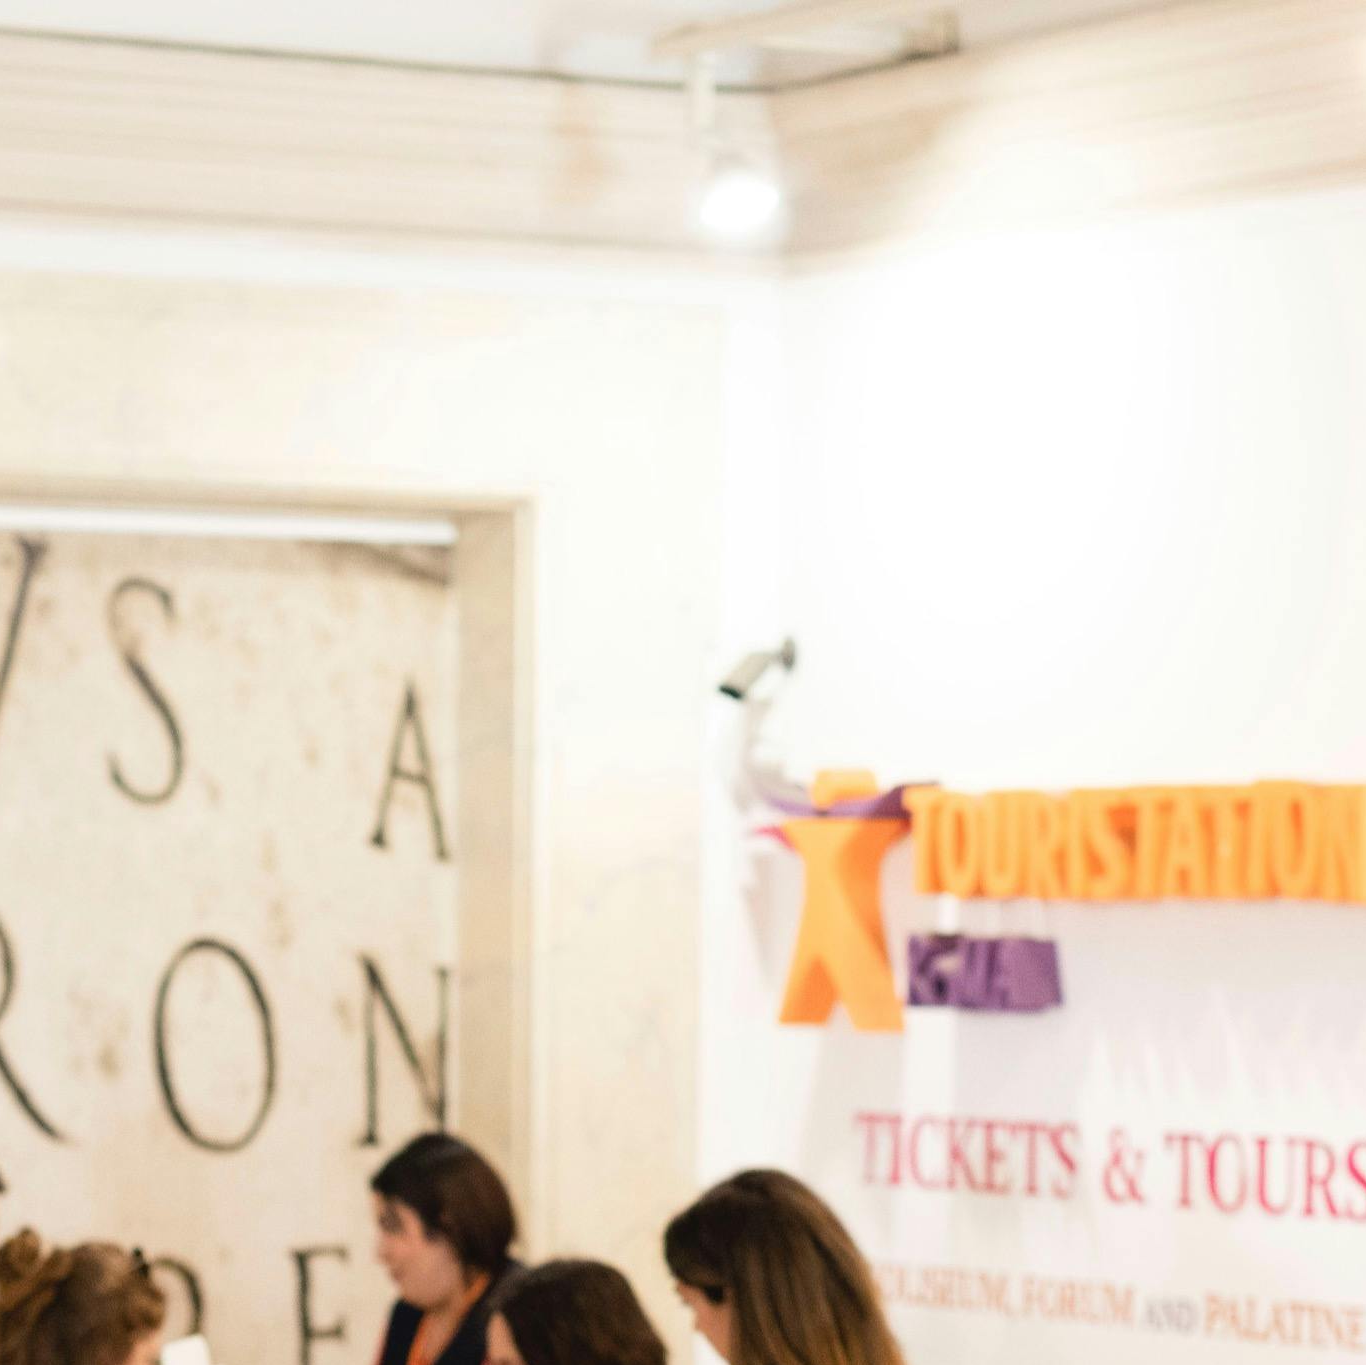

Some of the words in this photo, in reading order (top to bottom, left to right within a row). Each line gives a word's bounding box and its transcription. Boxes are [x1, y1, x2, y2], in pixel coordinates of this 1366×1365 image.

[903, 782, 1366, 905] TOURISTATION
[854, 1108, 1081, 1200] TICKETS
[1101, 1126, 1147, 1204] &
